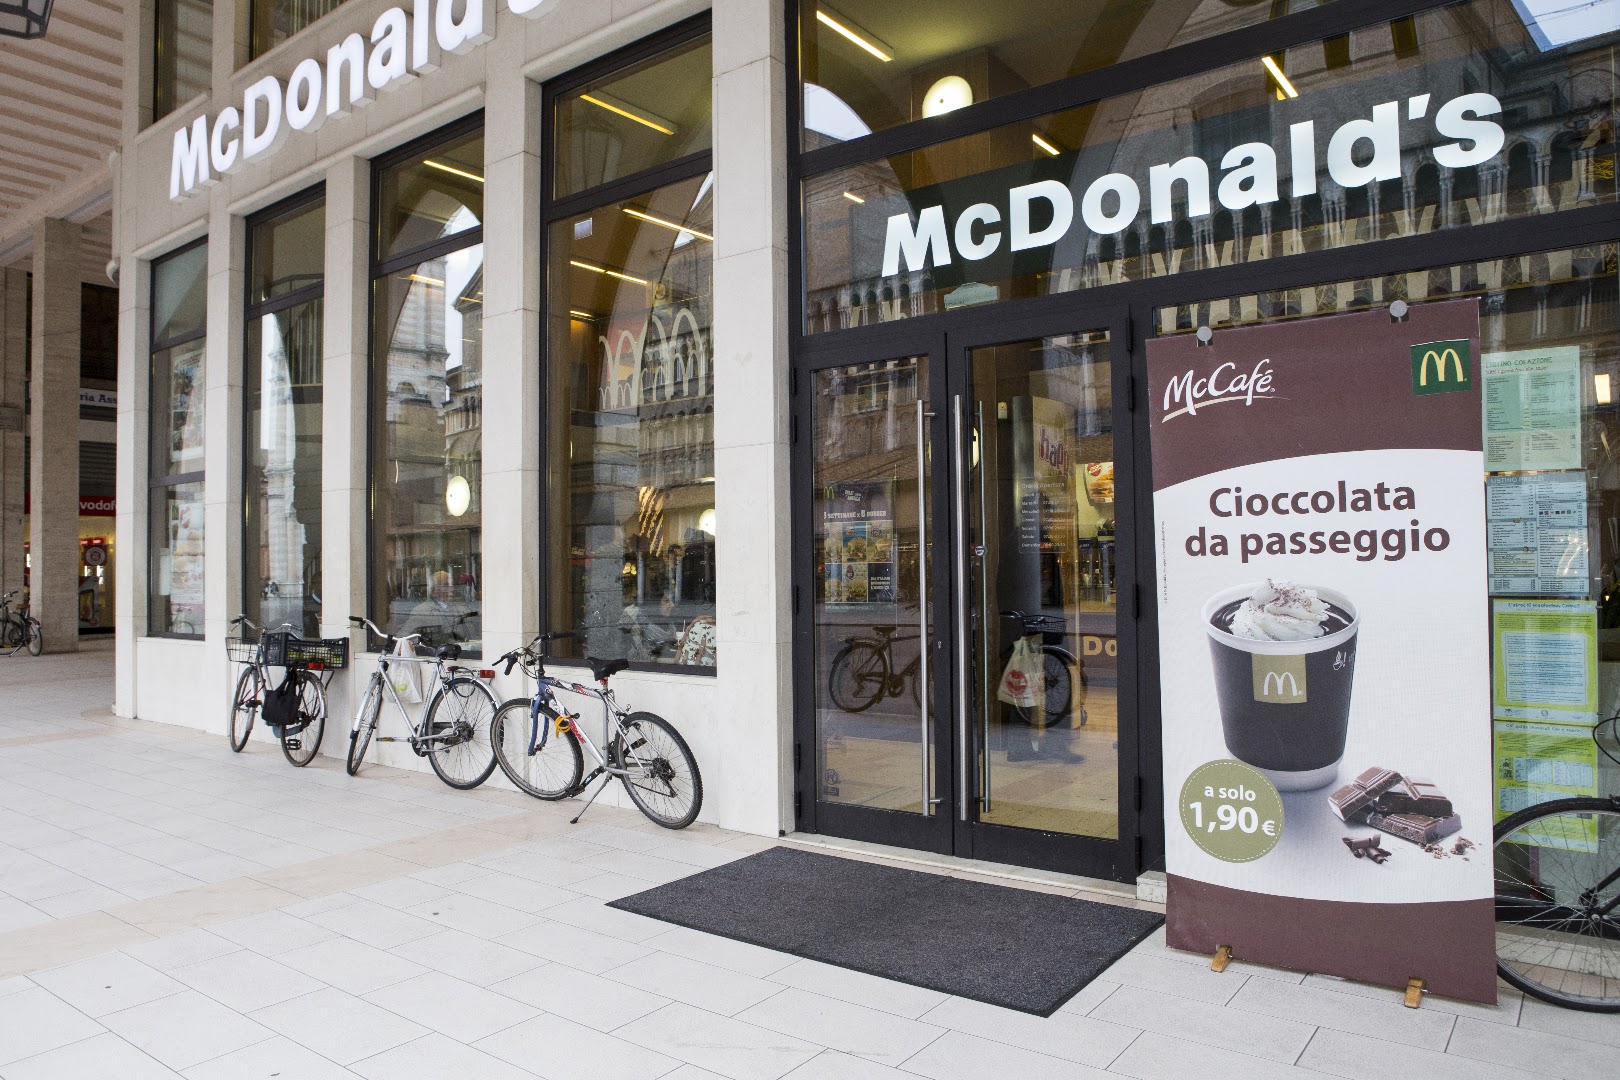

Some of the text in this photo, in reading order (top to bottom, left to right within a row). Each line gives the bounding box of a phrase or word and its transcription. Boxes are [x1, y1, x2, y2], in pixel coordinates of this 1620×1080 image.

[881, 91, 1506, 277] McDonald's
[1162, 358, 1274, 415] McCafé
[80, 499, 117, 511] vodaf
[1208, 480, 1416, 518] Cioccolata
[1184, 518, 1451, 564] da passeggio
[1204, 784, 1257, 802] a solo
